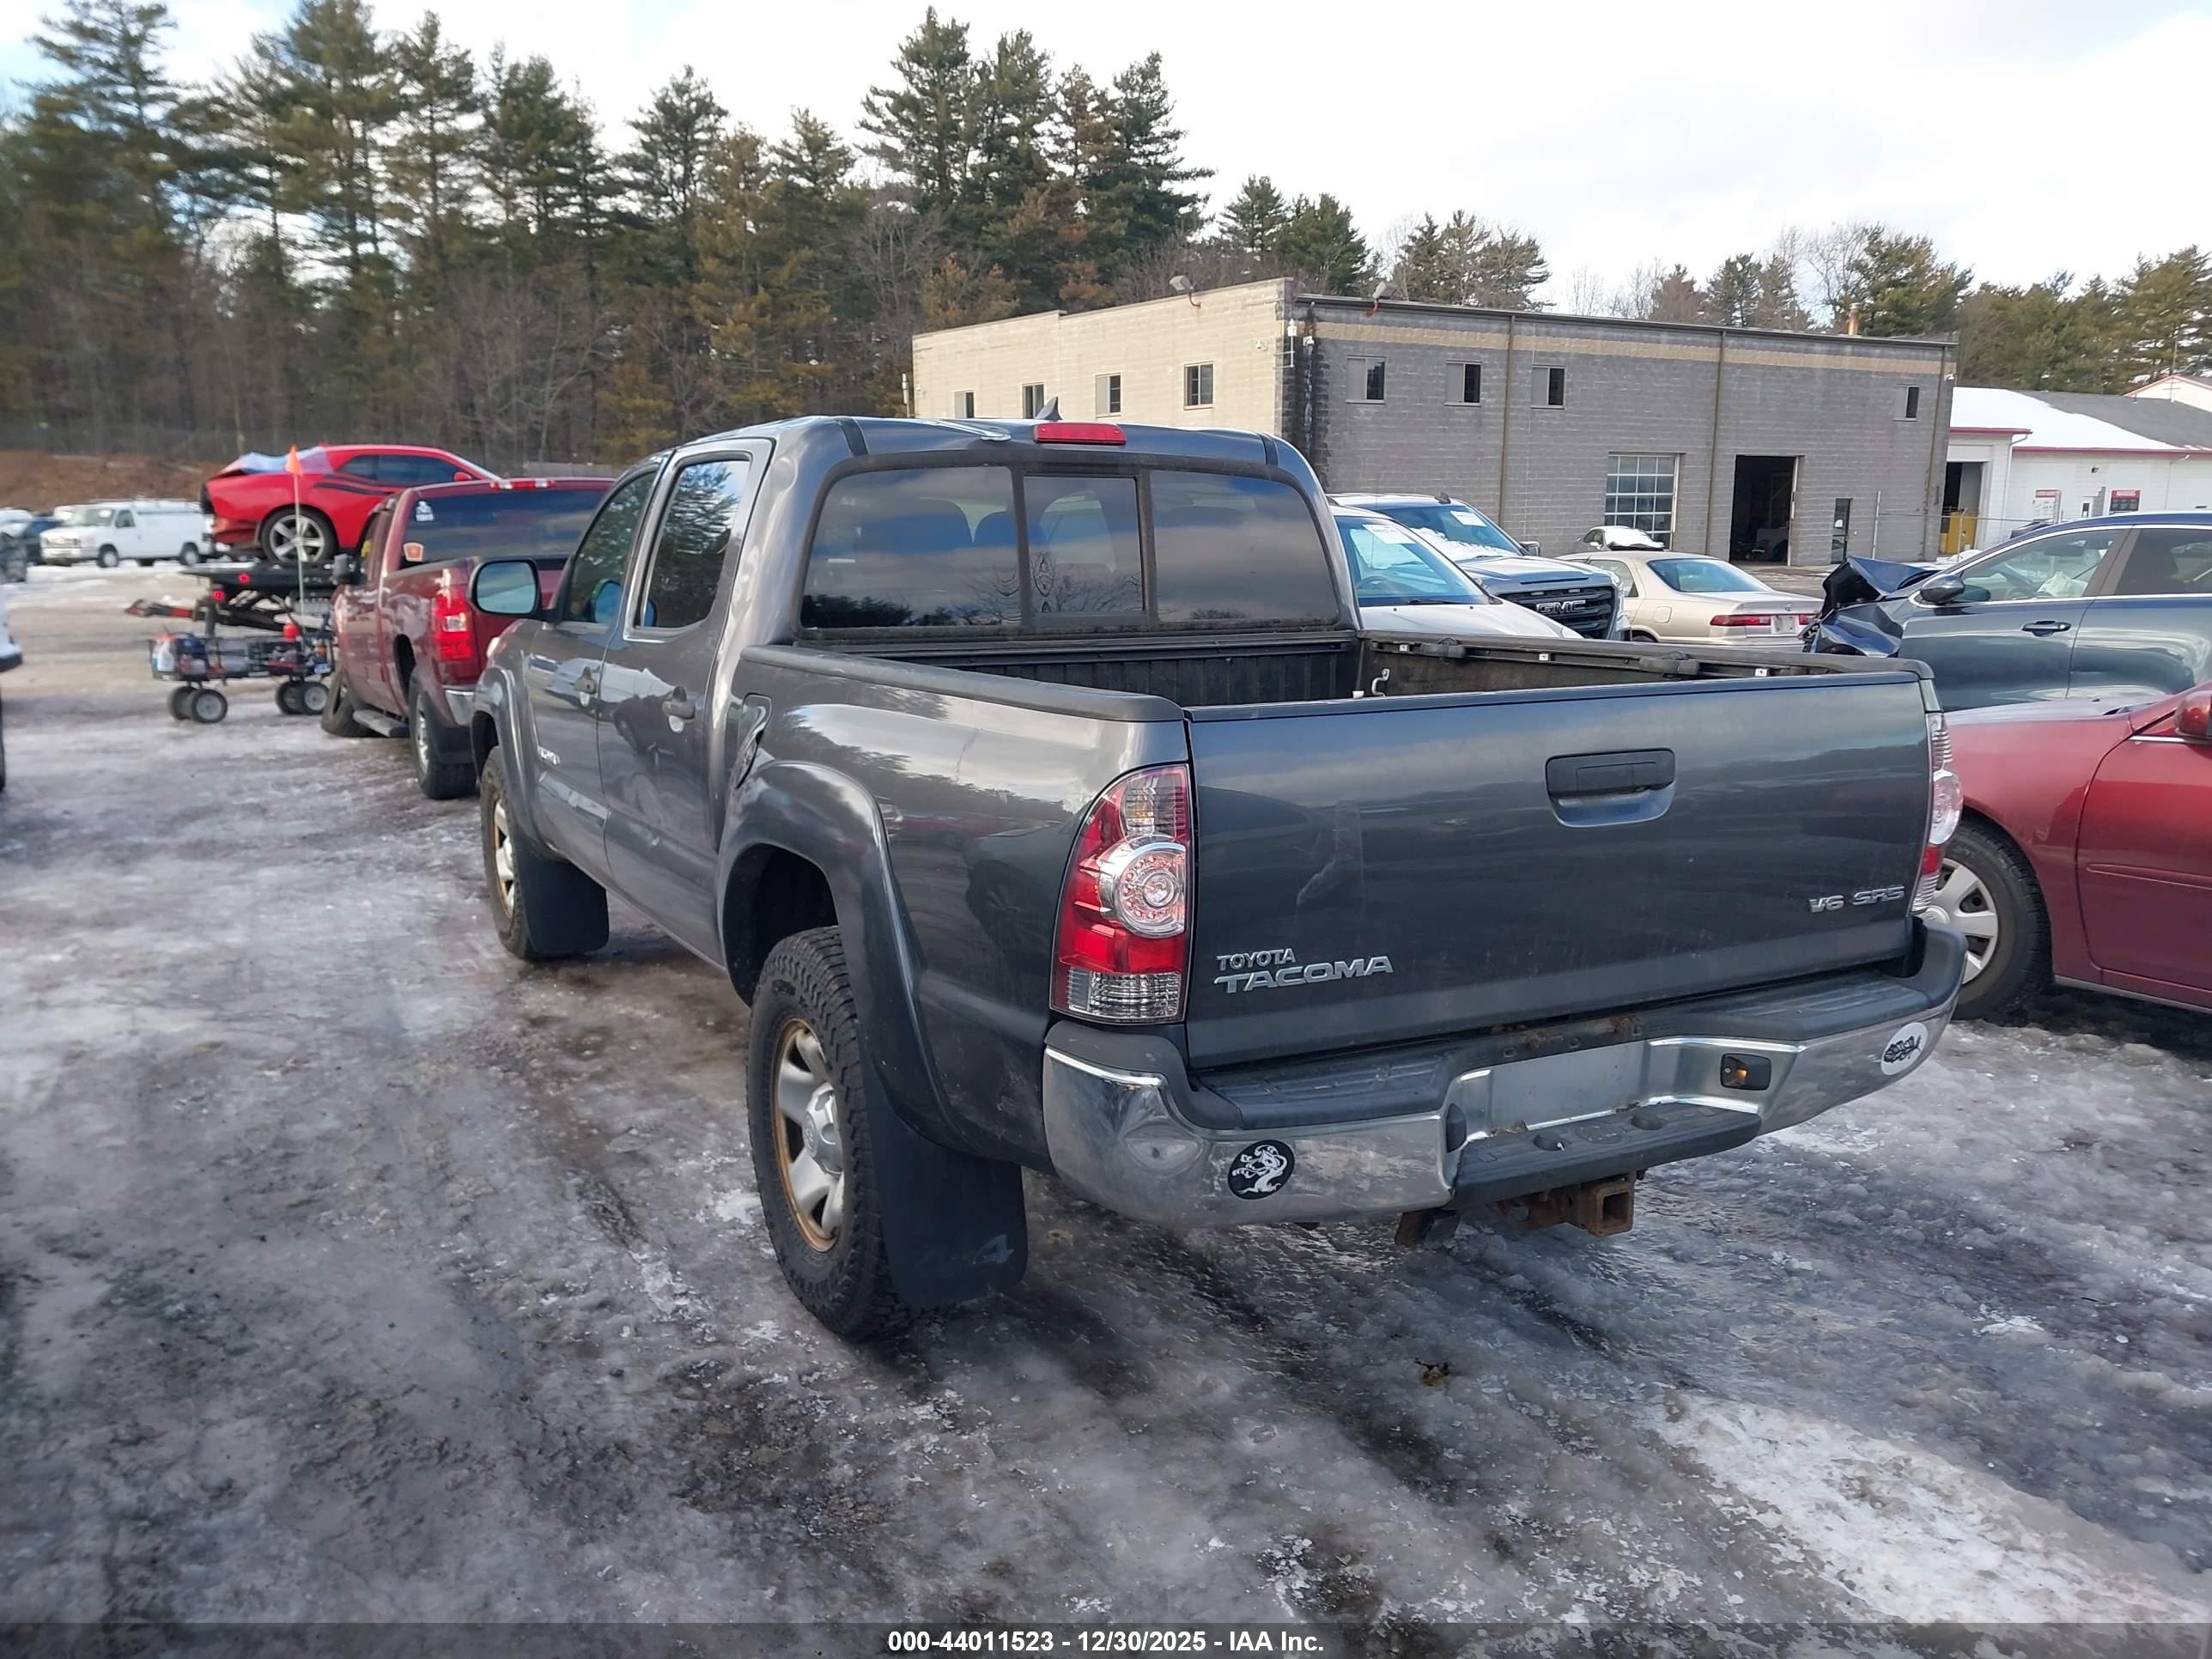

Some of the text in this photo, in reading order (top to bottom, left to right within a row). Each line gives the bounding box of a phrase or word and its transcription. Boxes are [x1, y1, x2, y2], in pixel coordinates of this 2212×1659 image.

[1535, 599, 1586, 614] GMC
[1808, 885, 1905, 913] V6 SR5
[1216, 947, 1297, 971] TOYOTA
[1213, 955, 1395, 994] TACOMA
